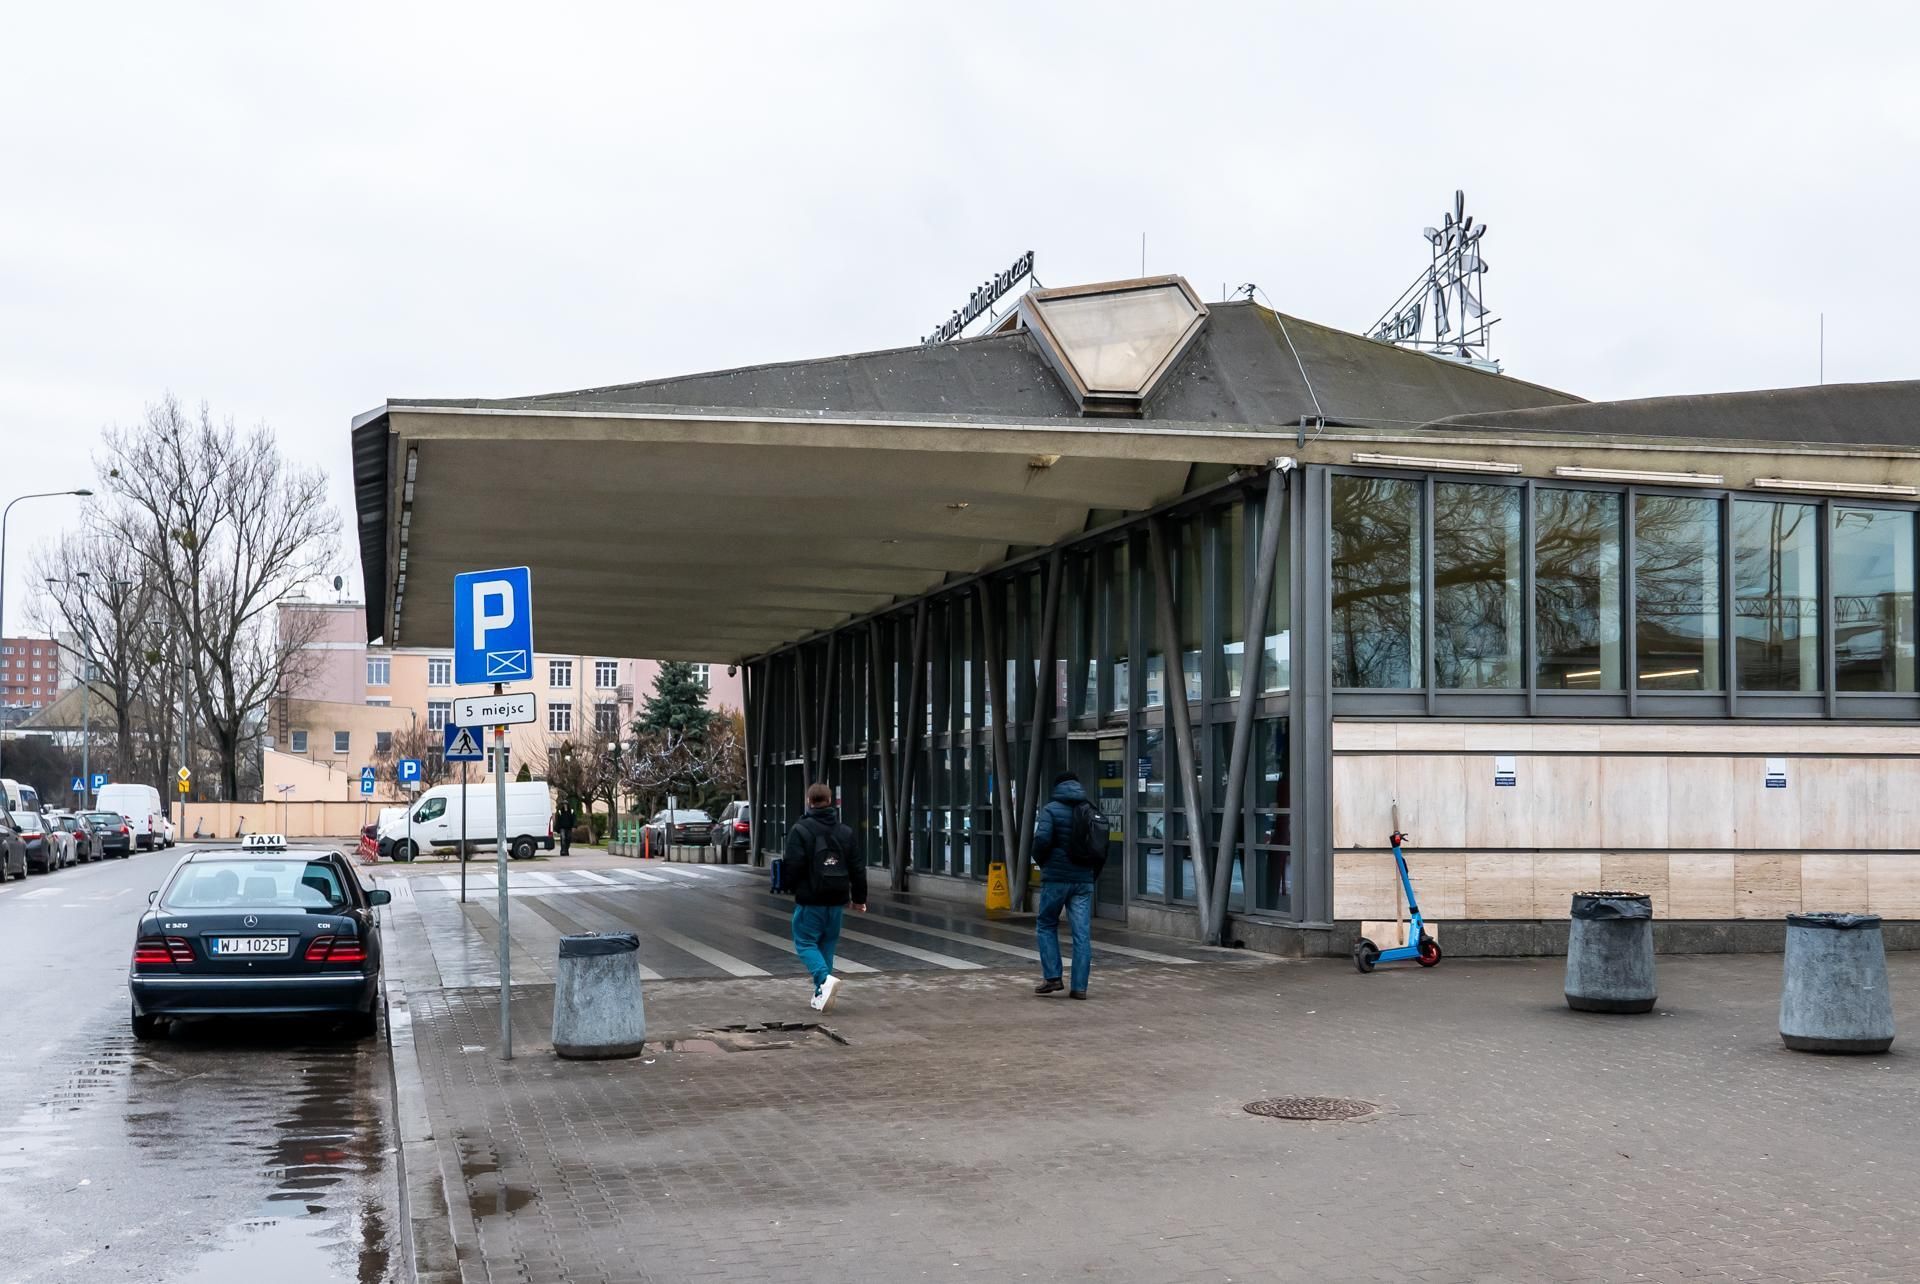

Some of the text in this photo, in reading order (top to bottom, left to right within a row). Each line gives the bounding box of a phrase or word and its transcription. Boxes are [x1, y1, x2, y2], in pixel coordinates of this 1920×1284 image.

[1010, 251, 1032, 284] czas
[473, 580, 514, 650] P
[466, 702, 524, 718] 5 miejsc
[404, 762, 417, 778] P
[95, 775, 104, 787] P
[364, 781, 372, 791] P
[249, 835, 281, 845] TAXI
[221, 939, 287, 952] WJ 1025F
